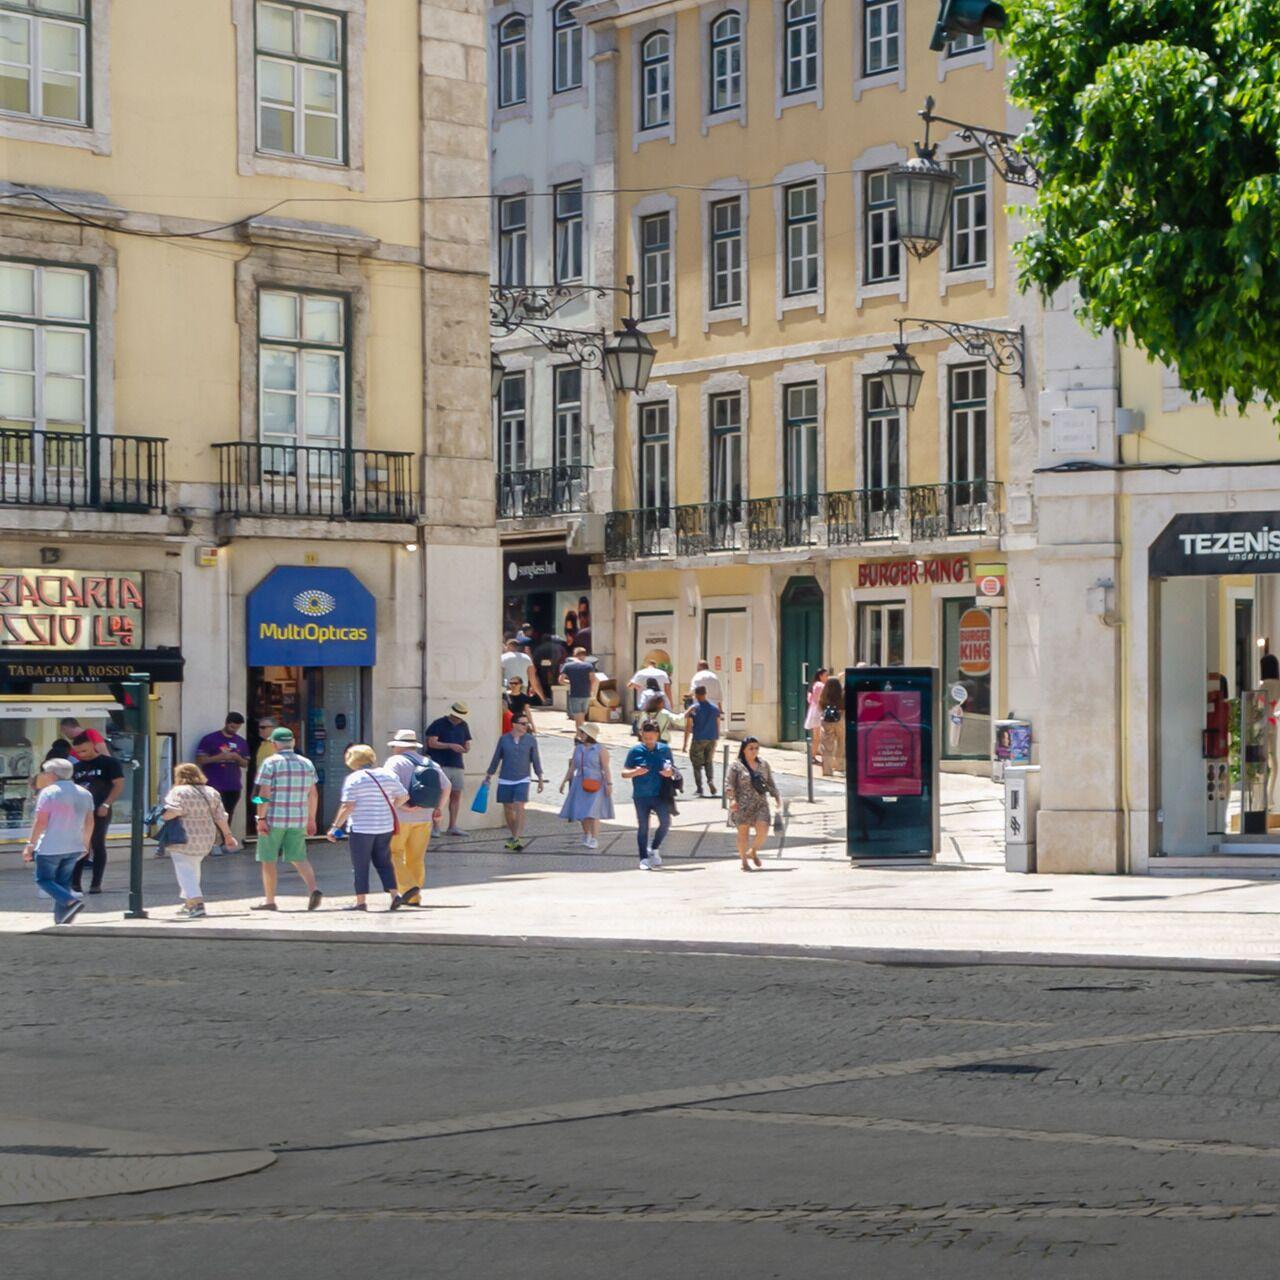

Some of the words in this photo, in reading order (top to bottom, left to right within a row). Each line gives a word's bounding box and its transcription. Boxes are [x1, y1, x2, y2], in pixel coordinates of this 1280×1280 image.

[40, 547, 62, 564] 13
[859, 560, 919, 587] BURGER
[924, 558, 965, 584] KING
[259, 623, 368, 643] MultiOpticas
[960, 630, 990, 641] BURGER
[960, 644, 990, 660] KING
[8, 665, 85, 677] TABACARIA
[88, 665, 134, 677] ROSSIO
